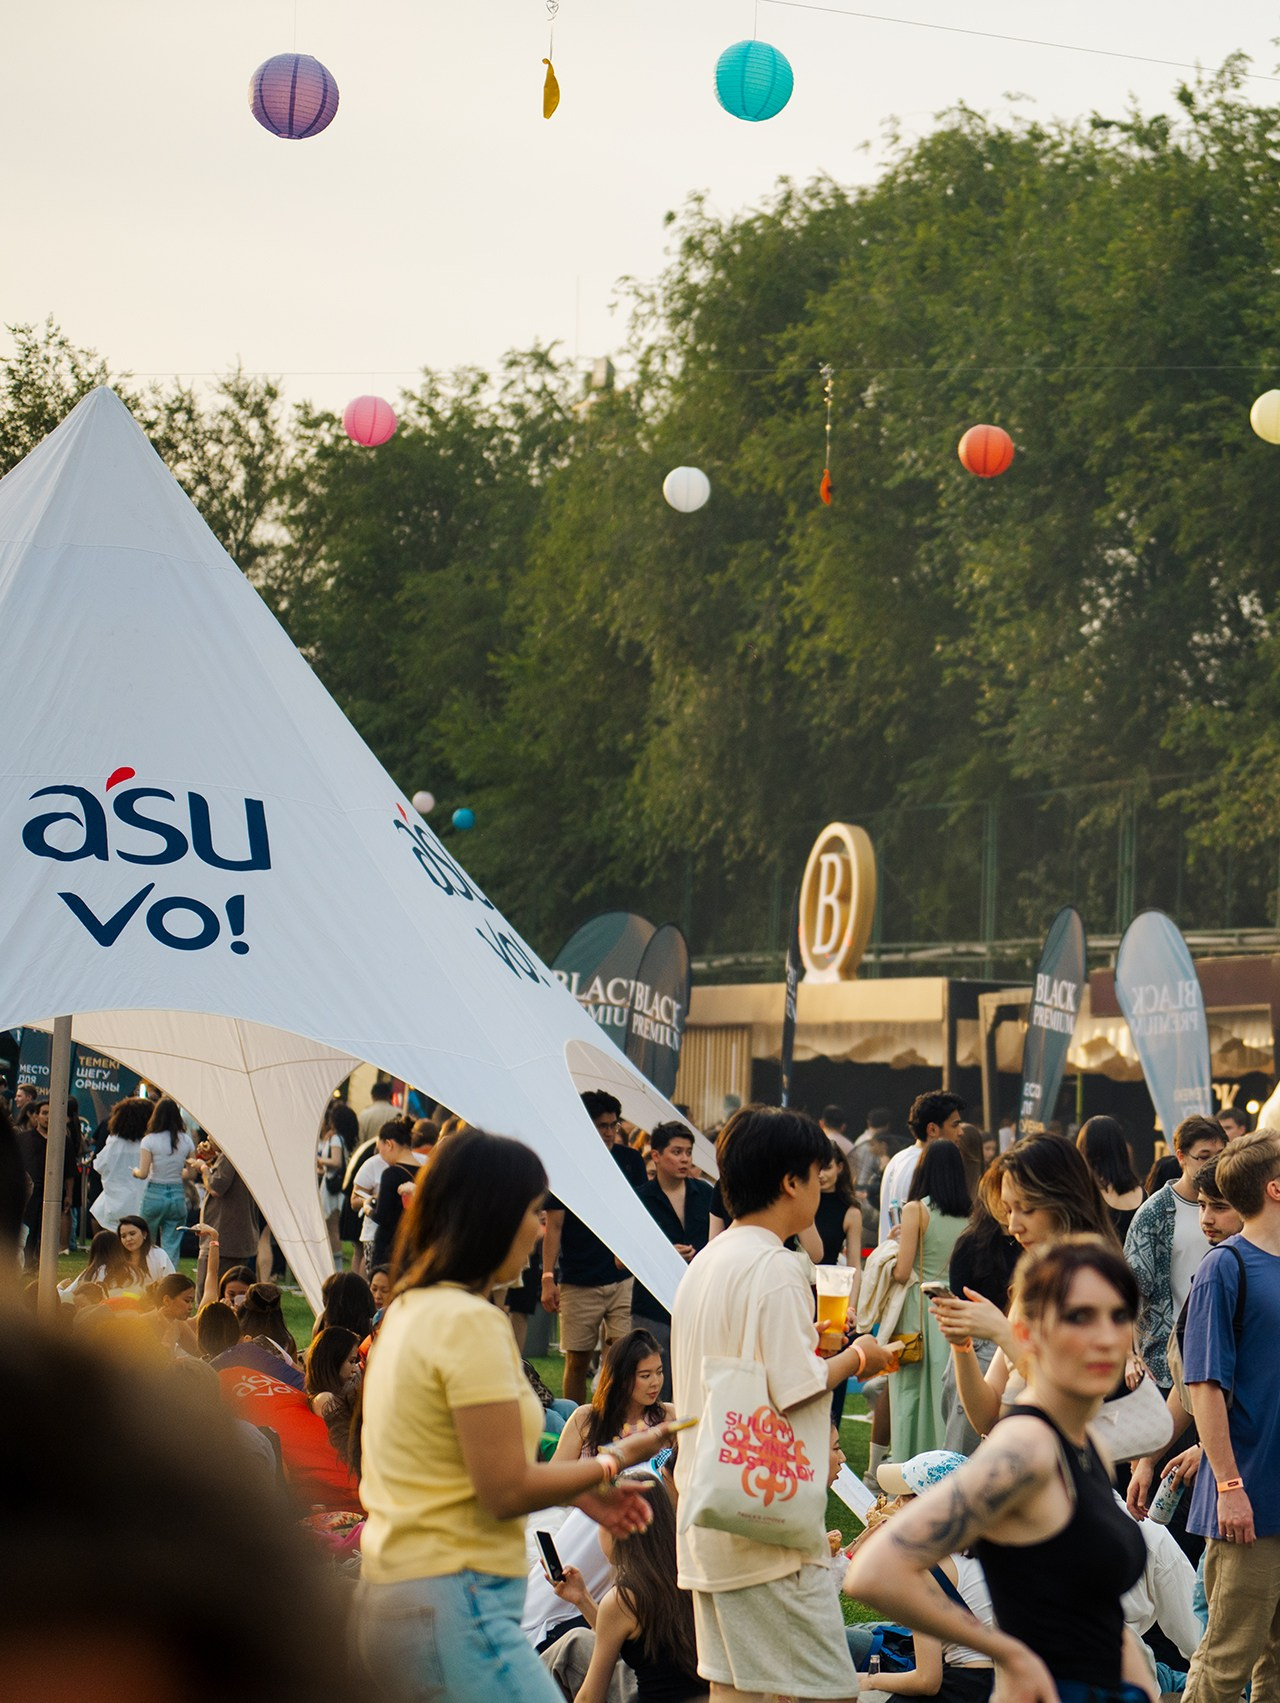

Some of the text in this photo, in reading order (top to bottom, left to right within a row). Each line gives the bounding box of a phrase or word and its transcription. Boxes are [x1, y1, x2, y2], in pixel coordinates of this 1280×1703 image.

[812, 852, 843, 954] B
[57, 882, 250, 955] vo!
[1035, 973, 1077, 1012] BLACK
[1032, 1005, 1075, 1035] PREMIUM
[17, 1074, 37, 1085] ДЛЯ
[20, 1064, 50, 1075] МЕСТО
[76, 1067, 110, 1079] ШЕГУ
[75, 1078, 120, 1092] ОРЫНЫ
